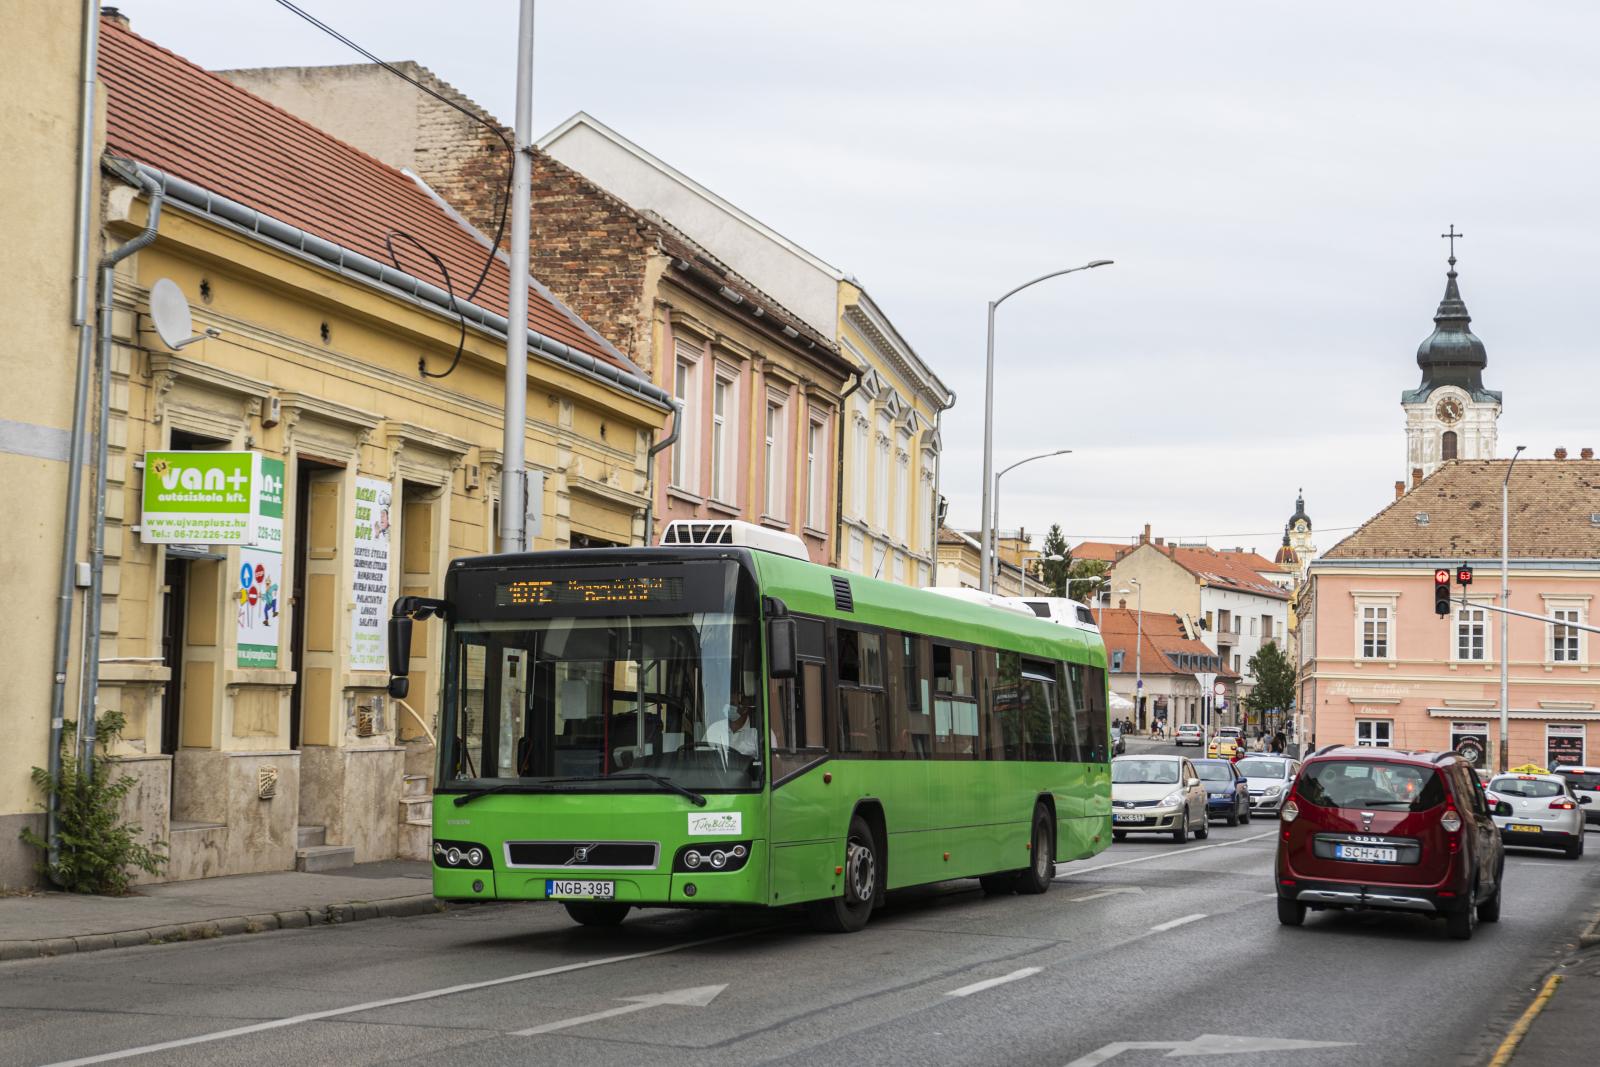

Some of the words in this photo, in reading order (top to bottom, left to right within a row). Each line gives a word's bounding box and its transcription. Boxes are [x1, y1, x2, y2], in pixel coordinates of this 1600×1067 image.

[162, 467, 248, 491] van+
[226, 493, 247, 503] kft.
[146, 518, 247, 528] www.ujvanplusz.hu
[1344, 847, 1393, 860] SCH-411
[555, 882, 610, 895] NGB-395
